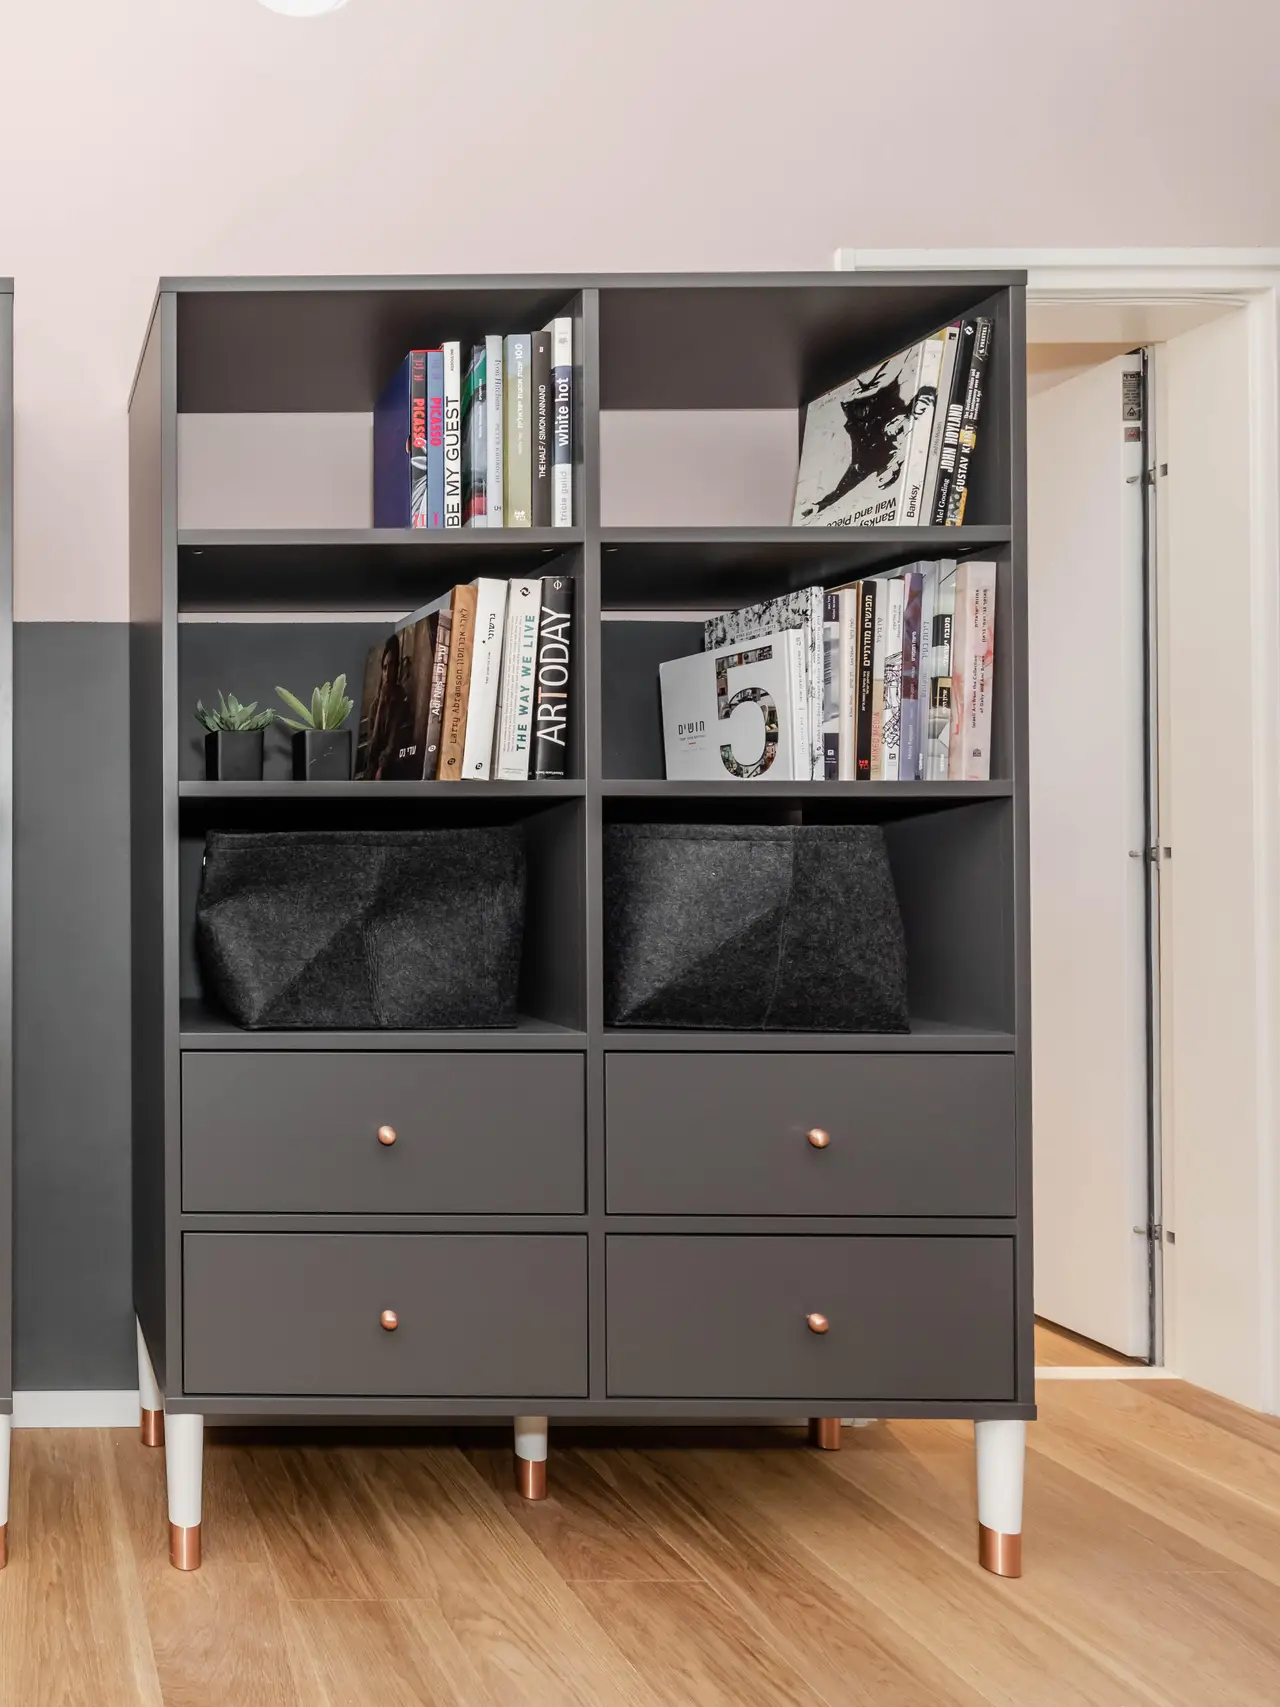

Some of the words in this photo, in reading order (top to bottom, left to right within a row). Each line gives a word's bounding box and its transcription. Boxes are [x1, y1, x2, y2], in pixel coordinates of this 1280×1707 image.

[515, 343, 523, 360] 100
[556, 377, 569, 402] hot
[413, 398, 425, 448] PICASSO
[431, 398, 442, 447] PICASSO
[446, 396, 459, 461] GUEST
[556, 406, 569, 446] white
[944, 404, 963, 445] HOYLAND
[941, 446, 957, 472] JOHN
[953, 457, 969, 492] GUSTAV
[962, 424, 974, 453] KLIMT
[447, 464, 459, 496] MY
[559, 471, 568, 494] guild
[939, 478, 950, 508] Gooding
[854, 506, 873, 521] and
[875, 497, 896, 515] Wall
[906, 485, 919, 518] Banksy
[447, 503, 459, 527] BE
[859, 510, 895, 526] Banksy
[936, 509, 945, 523] Mel
[460, 607, 468, 627] לארי
[864, 594, 873, 628] מפגשים
[487, 613, 496, 640] גרשוני
[524, 615, 535, 648] LIVE
[922, 621, 930, 641] דירות
[437, 644, 447, 660] עדי
[456, 631, 466, 665] אברמסון
[863, 631, 872, 666] מודרניים
[921, 643, 929, 660] בעיר
[436, 663, 445, 674] נס
[521, 656, 532, 677] WE
[536, 606, 571, 746] ARTODAY
[433, 681, 443, 698] Nes
[452, 669, 463, 714] Abramson
[519, 685, 530, 716] WAY
[431, 699, 441, 715] Adi
[715, 645, 779, 778] 5
[450, 717, 460, 744] Larry
[516, 724, 528, 751] THE
[678, 721, 705, 735] חושים
[399, 748, 406, 758] נס
[407, 745, 417, 755] עדי
